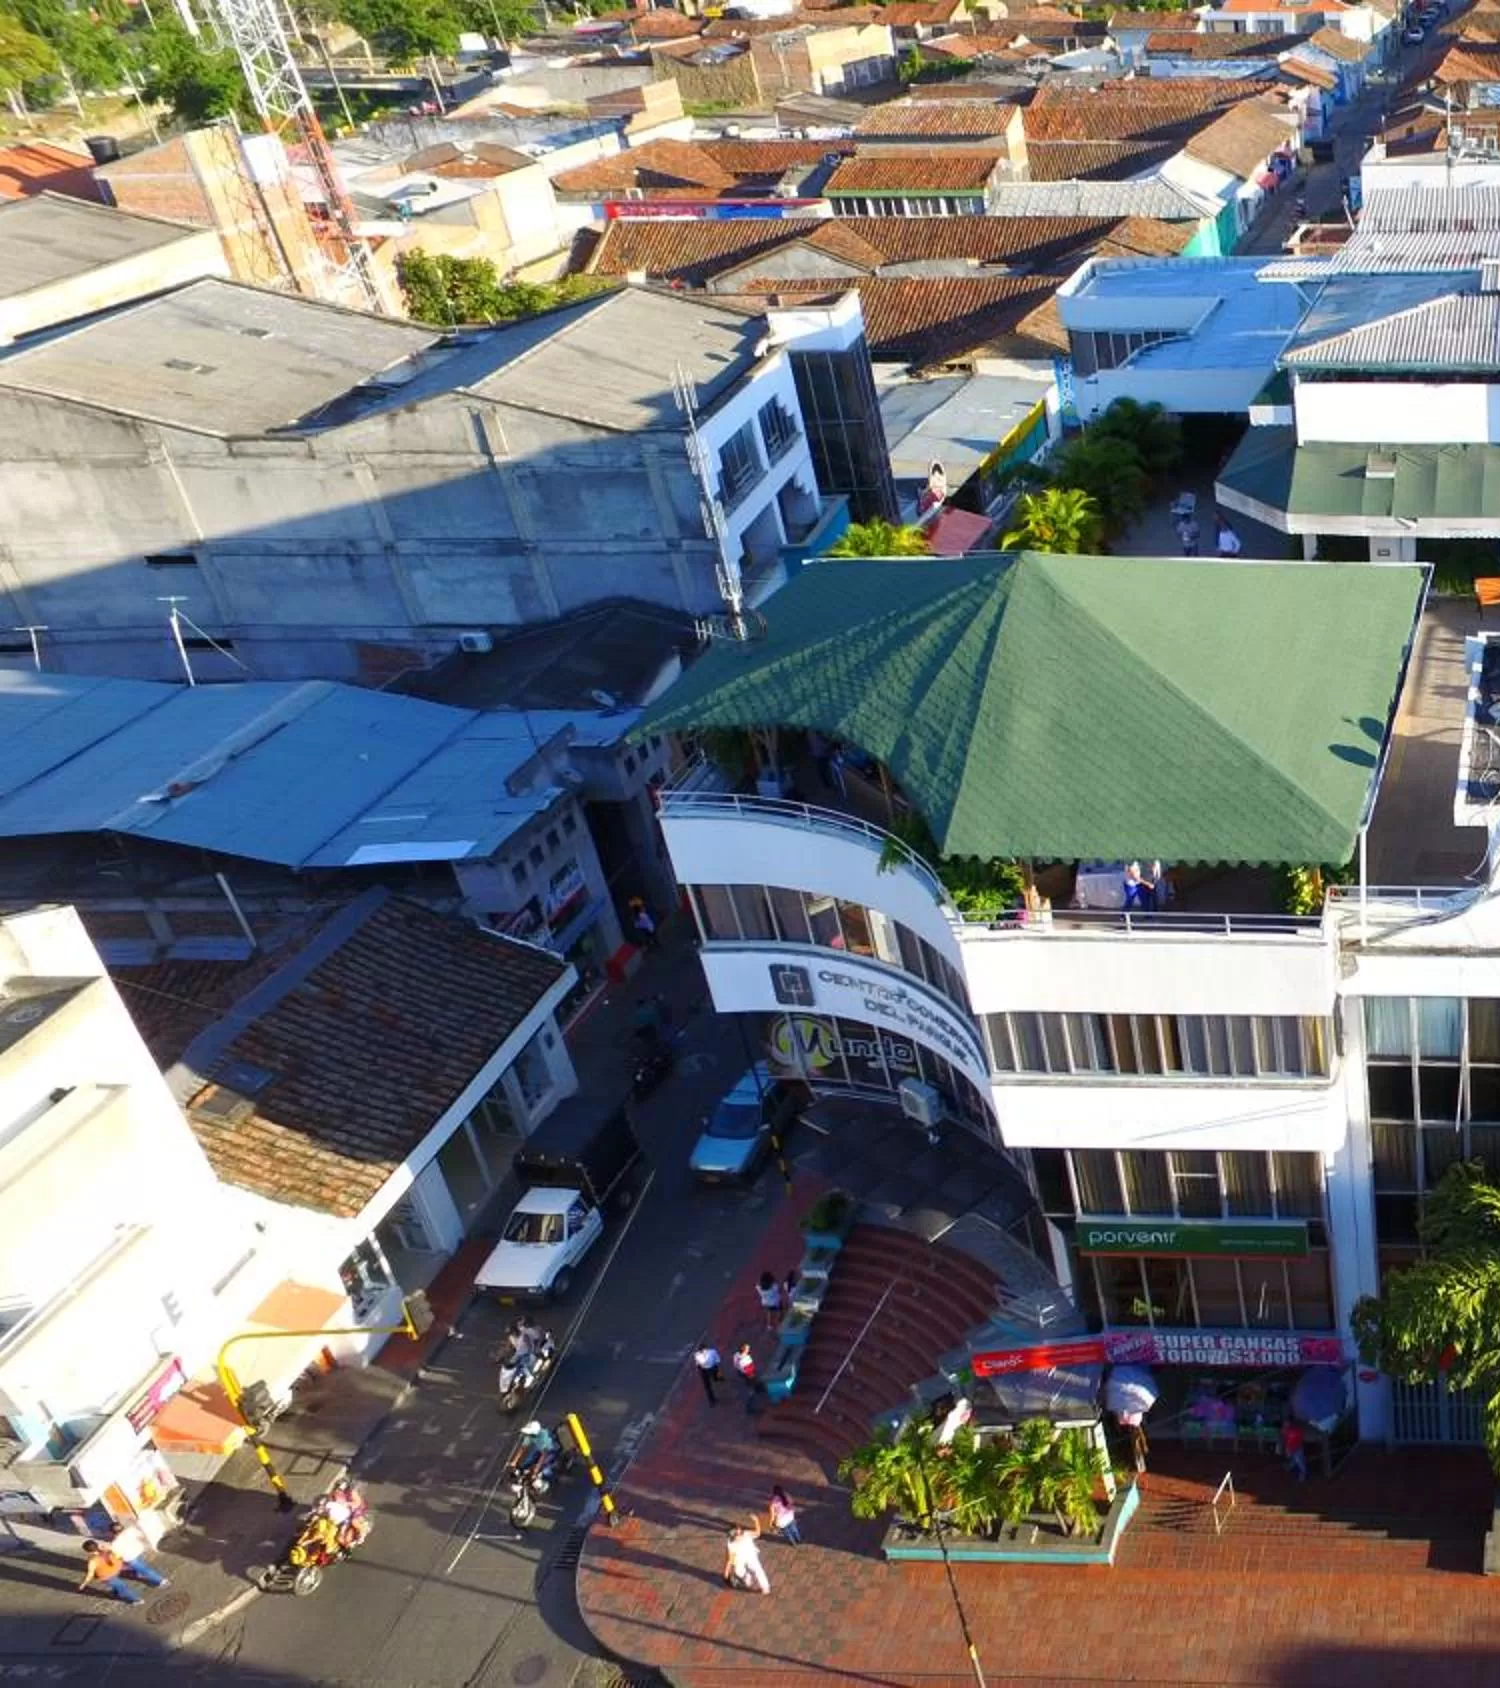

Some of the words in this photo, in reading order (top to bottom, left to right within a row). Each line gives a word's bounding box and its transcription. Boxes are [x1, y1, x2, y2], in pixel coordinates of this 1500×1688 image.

[818, 970, 908, 999] CENTRO
[1088, 1230, 1177, 1246] porvenir
[1154, 1335, 1216, 1350] SUPER
